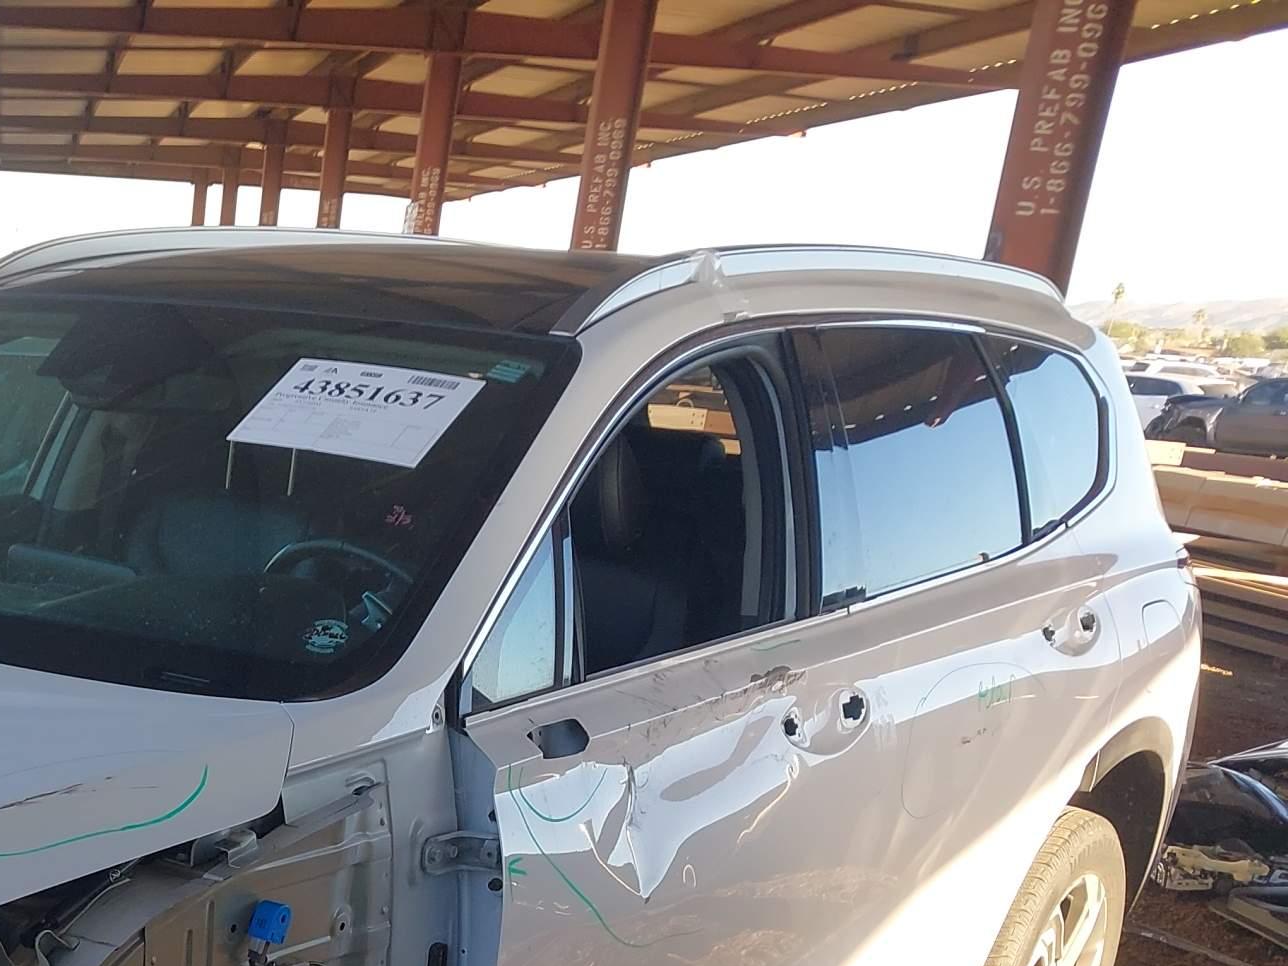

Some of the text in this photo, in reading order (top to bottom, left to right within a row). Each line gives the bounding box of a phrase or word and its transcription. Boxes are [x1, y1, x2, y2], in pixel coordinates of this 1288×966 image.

[1029, 49, 1072, 152] PREFAB
[587, 153, 607, 213] PREFAB
[293, 378, 446, 410] 43851637
